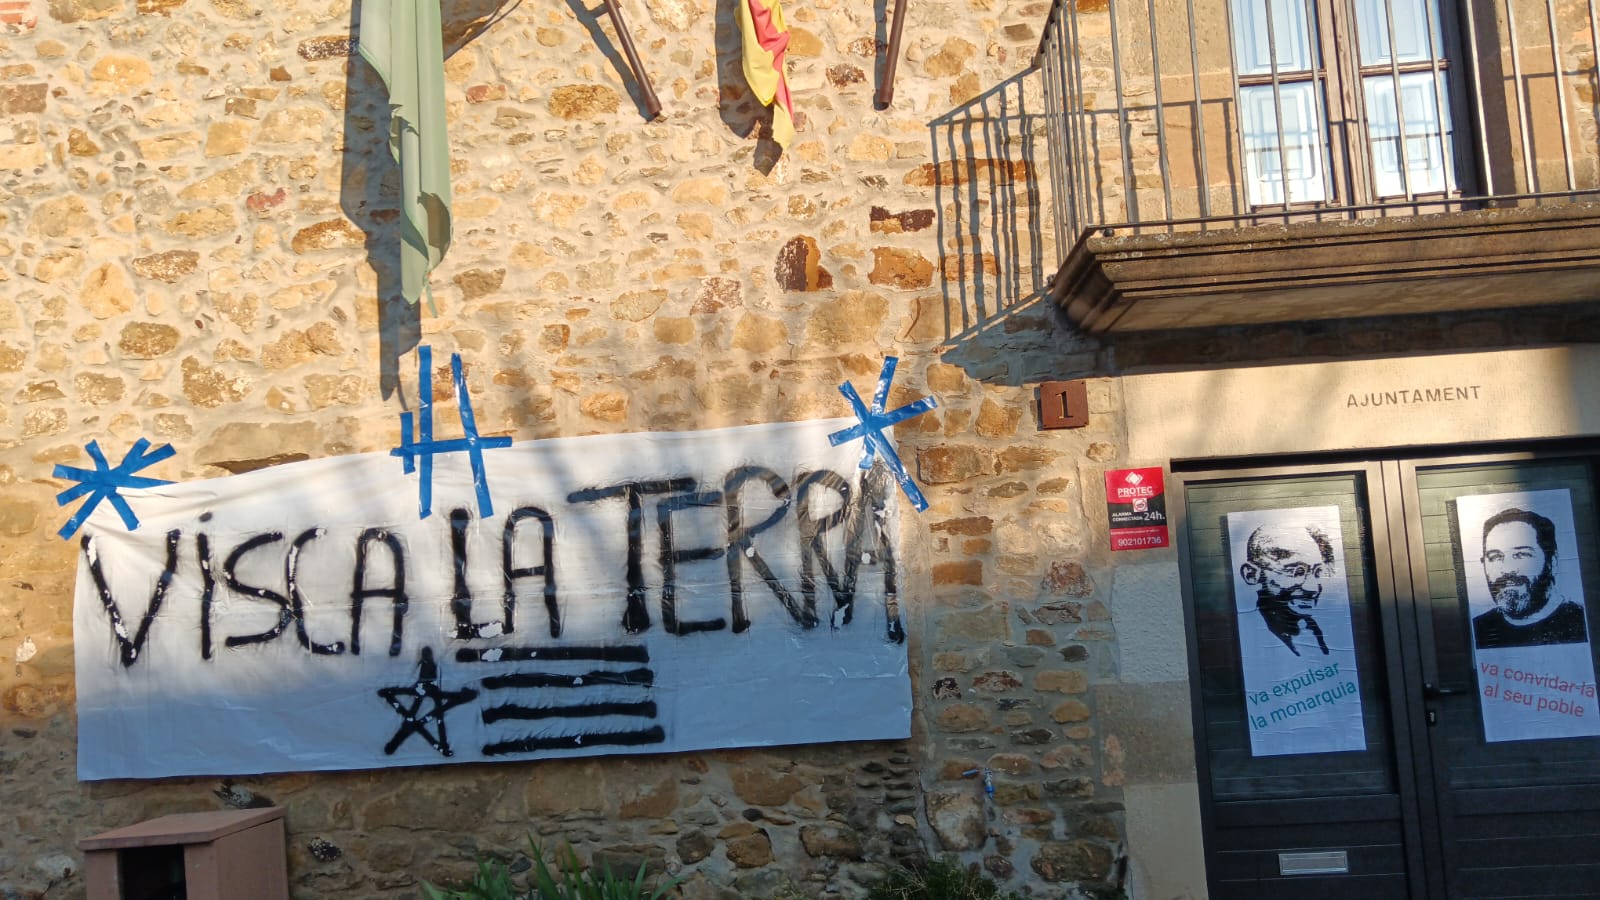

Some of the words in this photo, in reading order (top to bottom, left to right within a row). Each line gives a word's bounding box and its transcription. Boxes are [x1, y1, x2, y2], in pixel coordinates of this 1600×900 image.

[1055, 390, 1074, 419] 1
[1347, 385, 1481, 408] AJUNTAMENT
[1117, 486, 1153, 497] PROTEC
[1118, 536, 1162, 547] 902101736
[450, 505, 561, 639] LA
[1249, 691, 1270, 706] va
[1272, 662, 1339, 695] expulsar
[1480, 662, 1499, 676] va
[1503, 667, 1596, 698] convidar-la
[1250, 714, 1268, 730] la
[1270, 681, 1357, 722] monarquia
[1483, 682, 1500, 698] al
[1503, 688, 1533, 706] seu
[1537, 696, 1585, 717] poble
